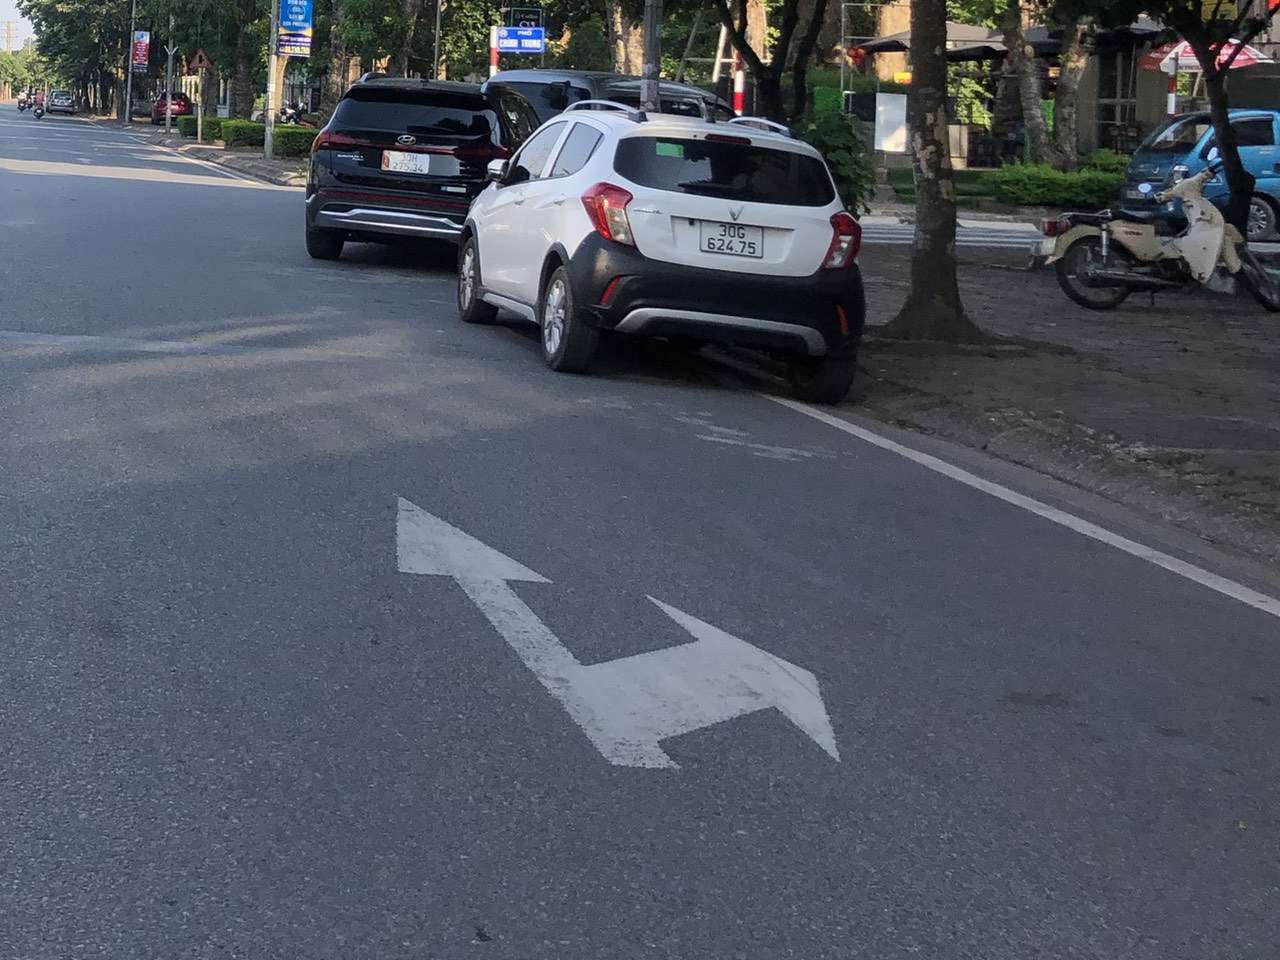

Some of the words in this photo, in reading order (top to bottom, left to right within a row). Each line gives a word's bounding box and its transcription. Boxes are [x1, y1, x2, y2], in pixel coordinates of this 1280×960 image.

[400, 153, 418, 163] 30H
[392, 161, 424, 173] 275.34
[719, 224, 746, 239] 30G
[707, 237, 756, 255] 624.75
